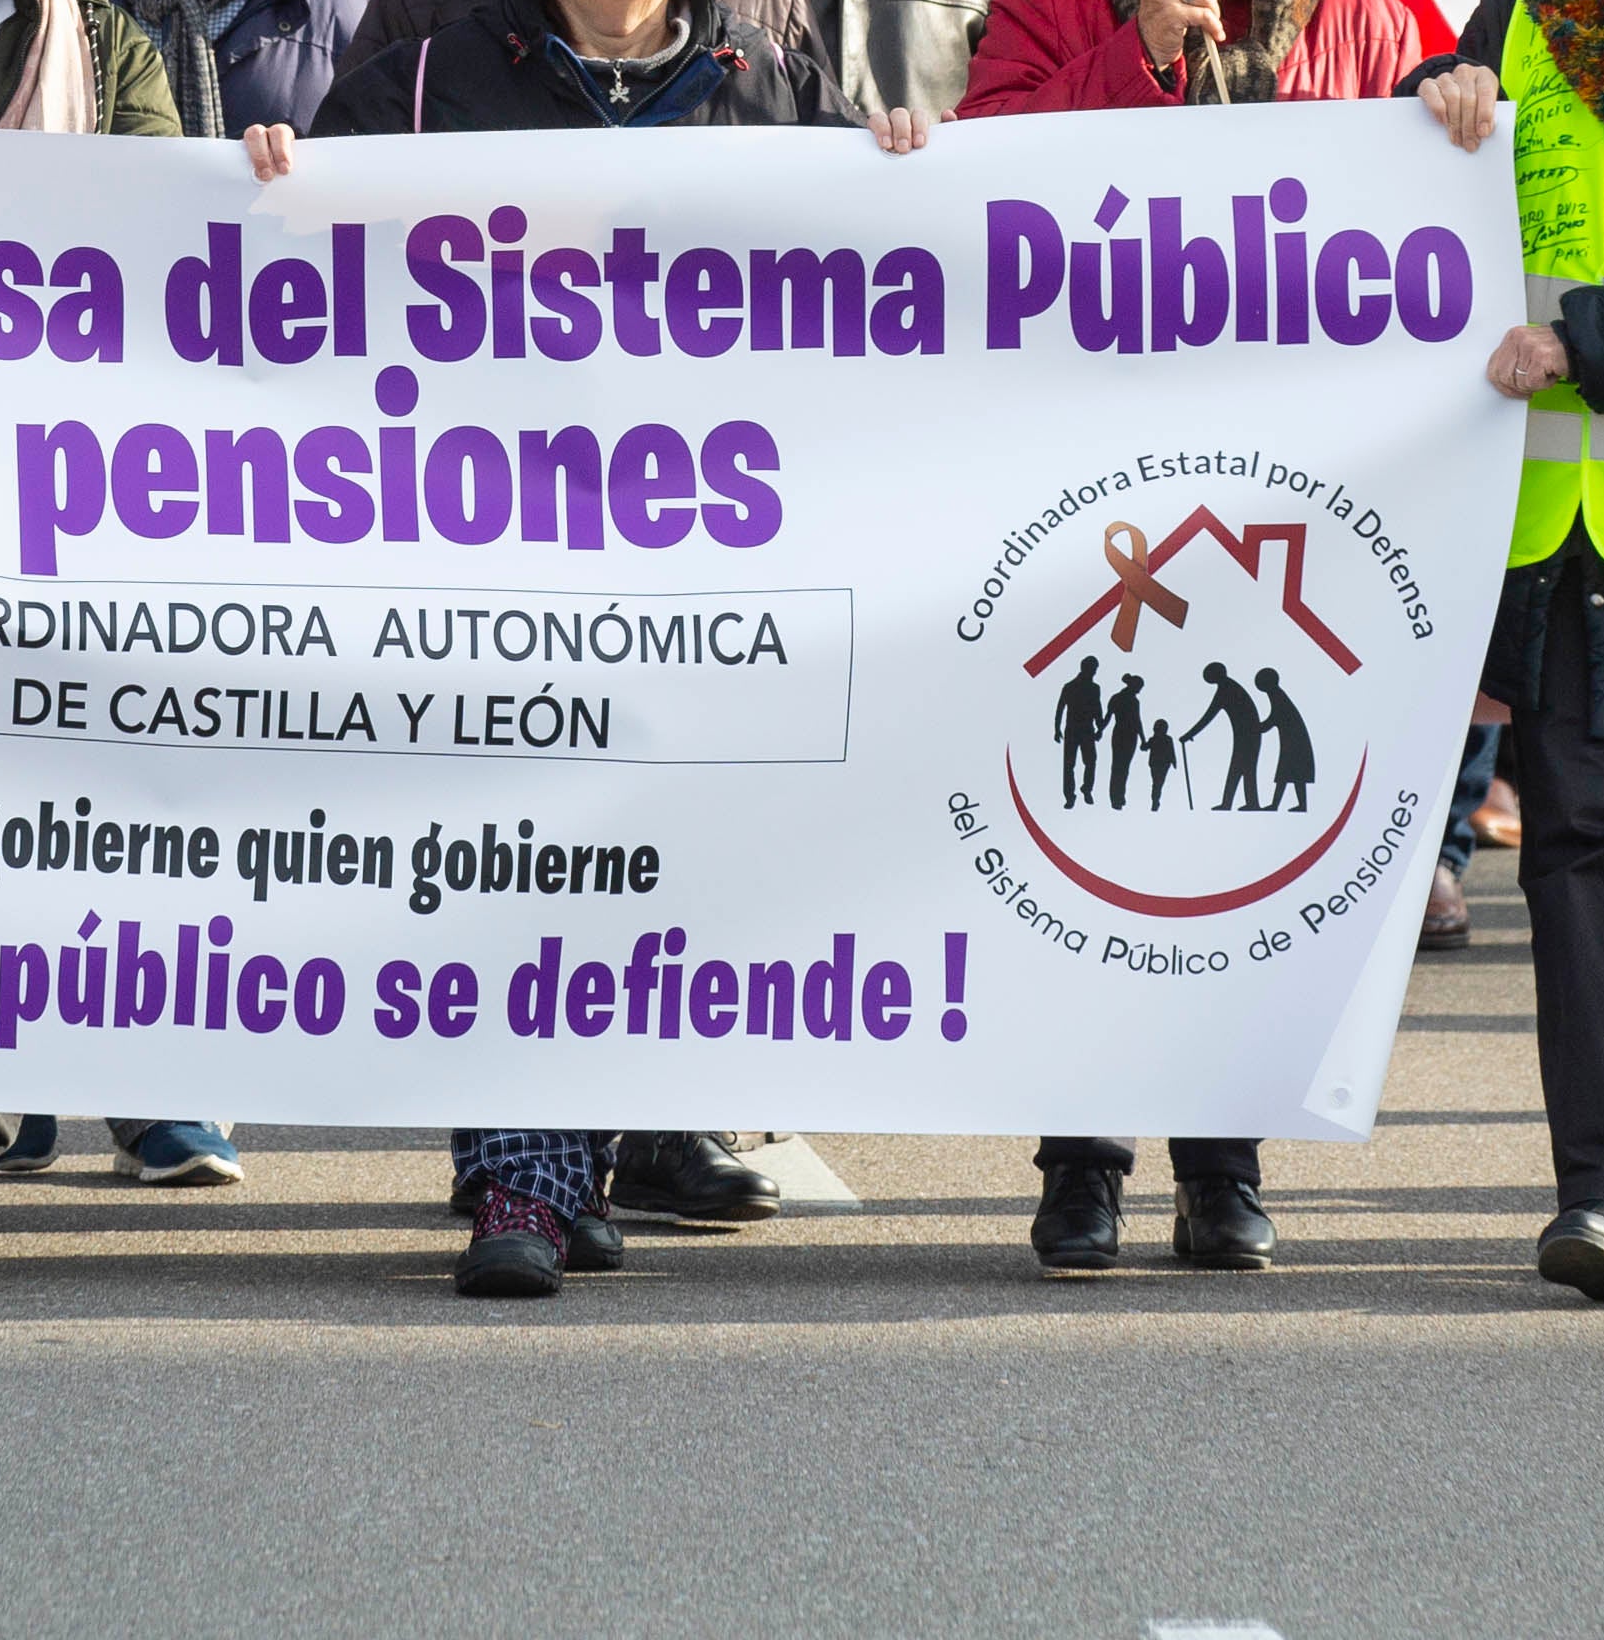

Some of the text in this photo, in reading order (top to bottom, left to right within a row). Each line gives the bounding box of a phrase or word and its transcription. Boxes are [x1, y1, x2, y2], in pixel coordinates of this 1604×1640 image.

[163, 221, 367, 367] del
[405, 203, 946, 361] Sistema
[984, 176, 1475, 356] Público
[16, 365, 784, 576] pensiones
[956, 451, 1435, 644] Coordinadora Estatal por la Defensa
[373, 599, 789, 668] AUTONÓMICA
[12, 677, 612, 752] DE CASTILLA Y LEÓN
[236, 808, 393, 904] quien
[407, 819, 661, 916] gobierne
[947, 788, 1420, 977] del Sistema Público de Pensiones
[374, 962, 477, 1042] se
[507, 930, 914, 1044] defiende
